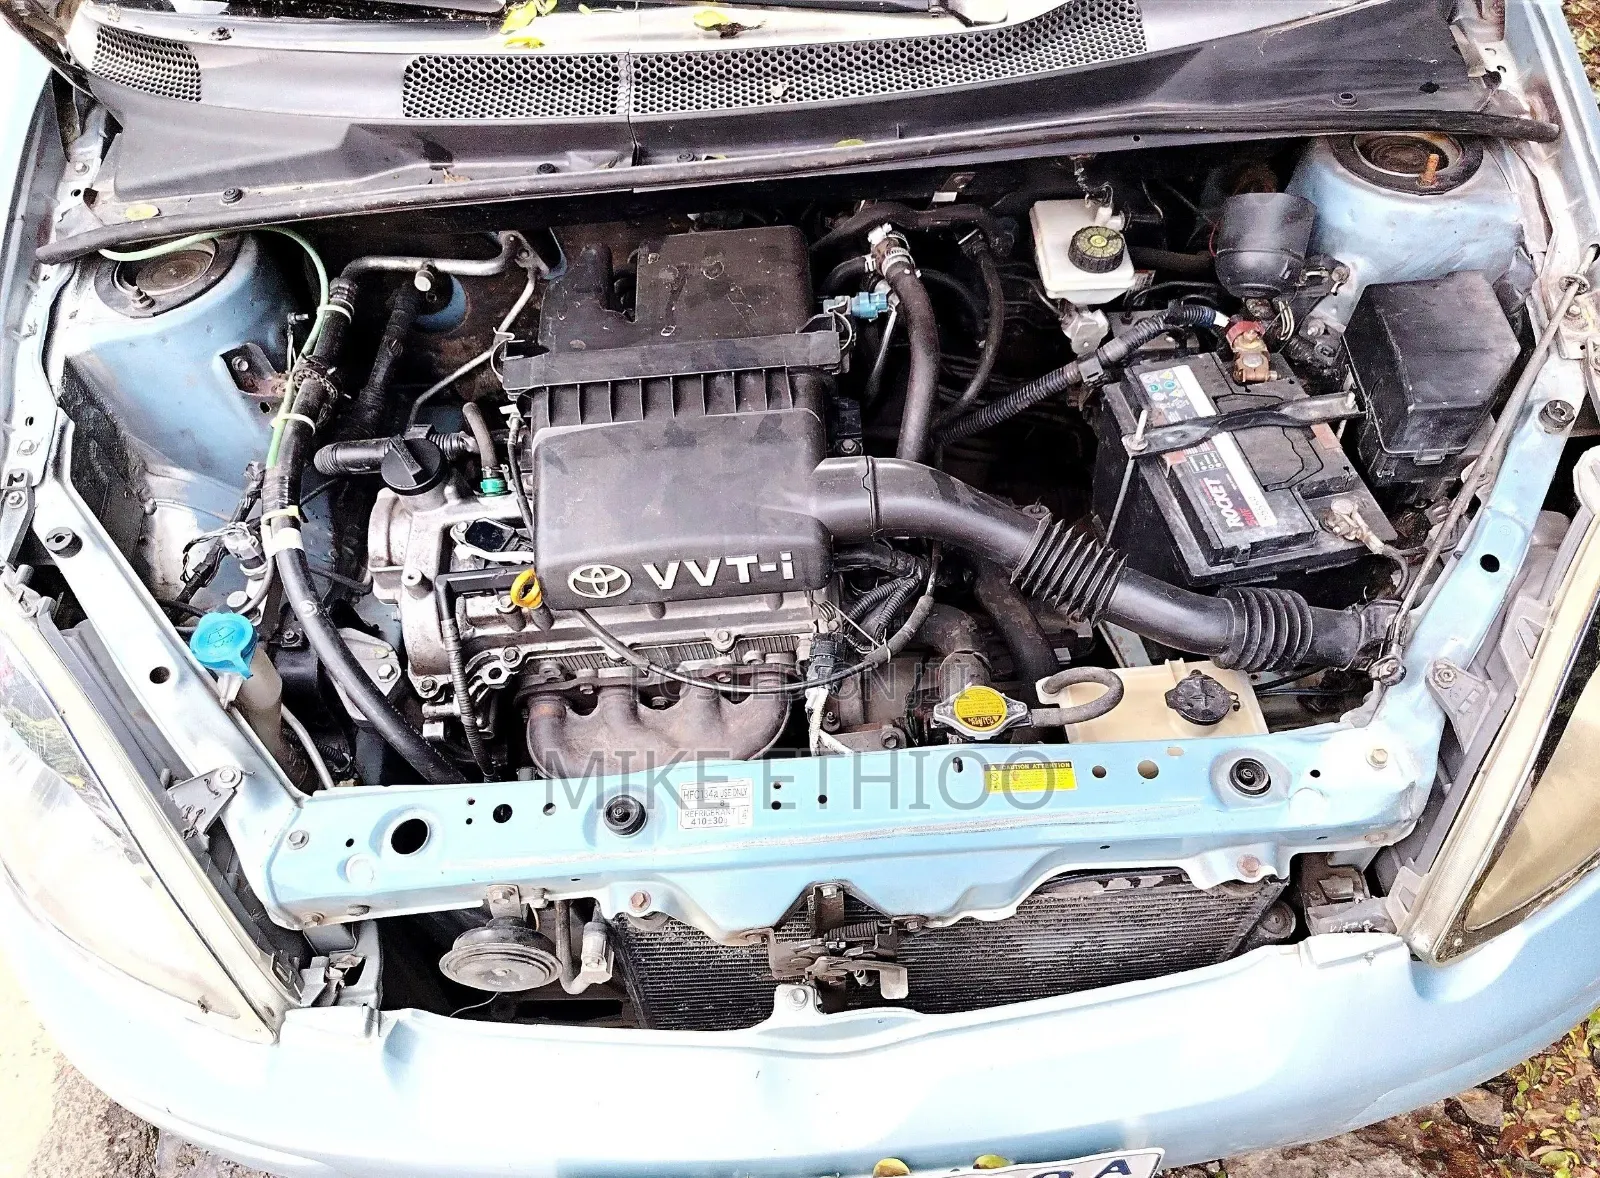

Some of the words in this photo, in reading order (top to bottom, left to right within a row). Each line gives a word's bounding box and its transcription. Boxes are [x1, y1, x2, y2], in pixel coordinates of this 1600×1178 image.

[1203, 477, 1245, 527] ROCKET
[642, 550, 794, 590] VVT-i
[683, 789, 719, 800] HFC134a
[720, 788, 732, 798] USE
[733, 787, 748, 797] ONLY
[684, 808, 736, 818] REFRIGERANT
